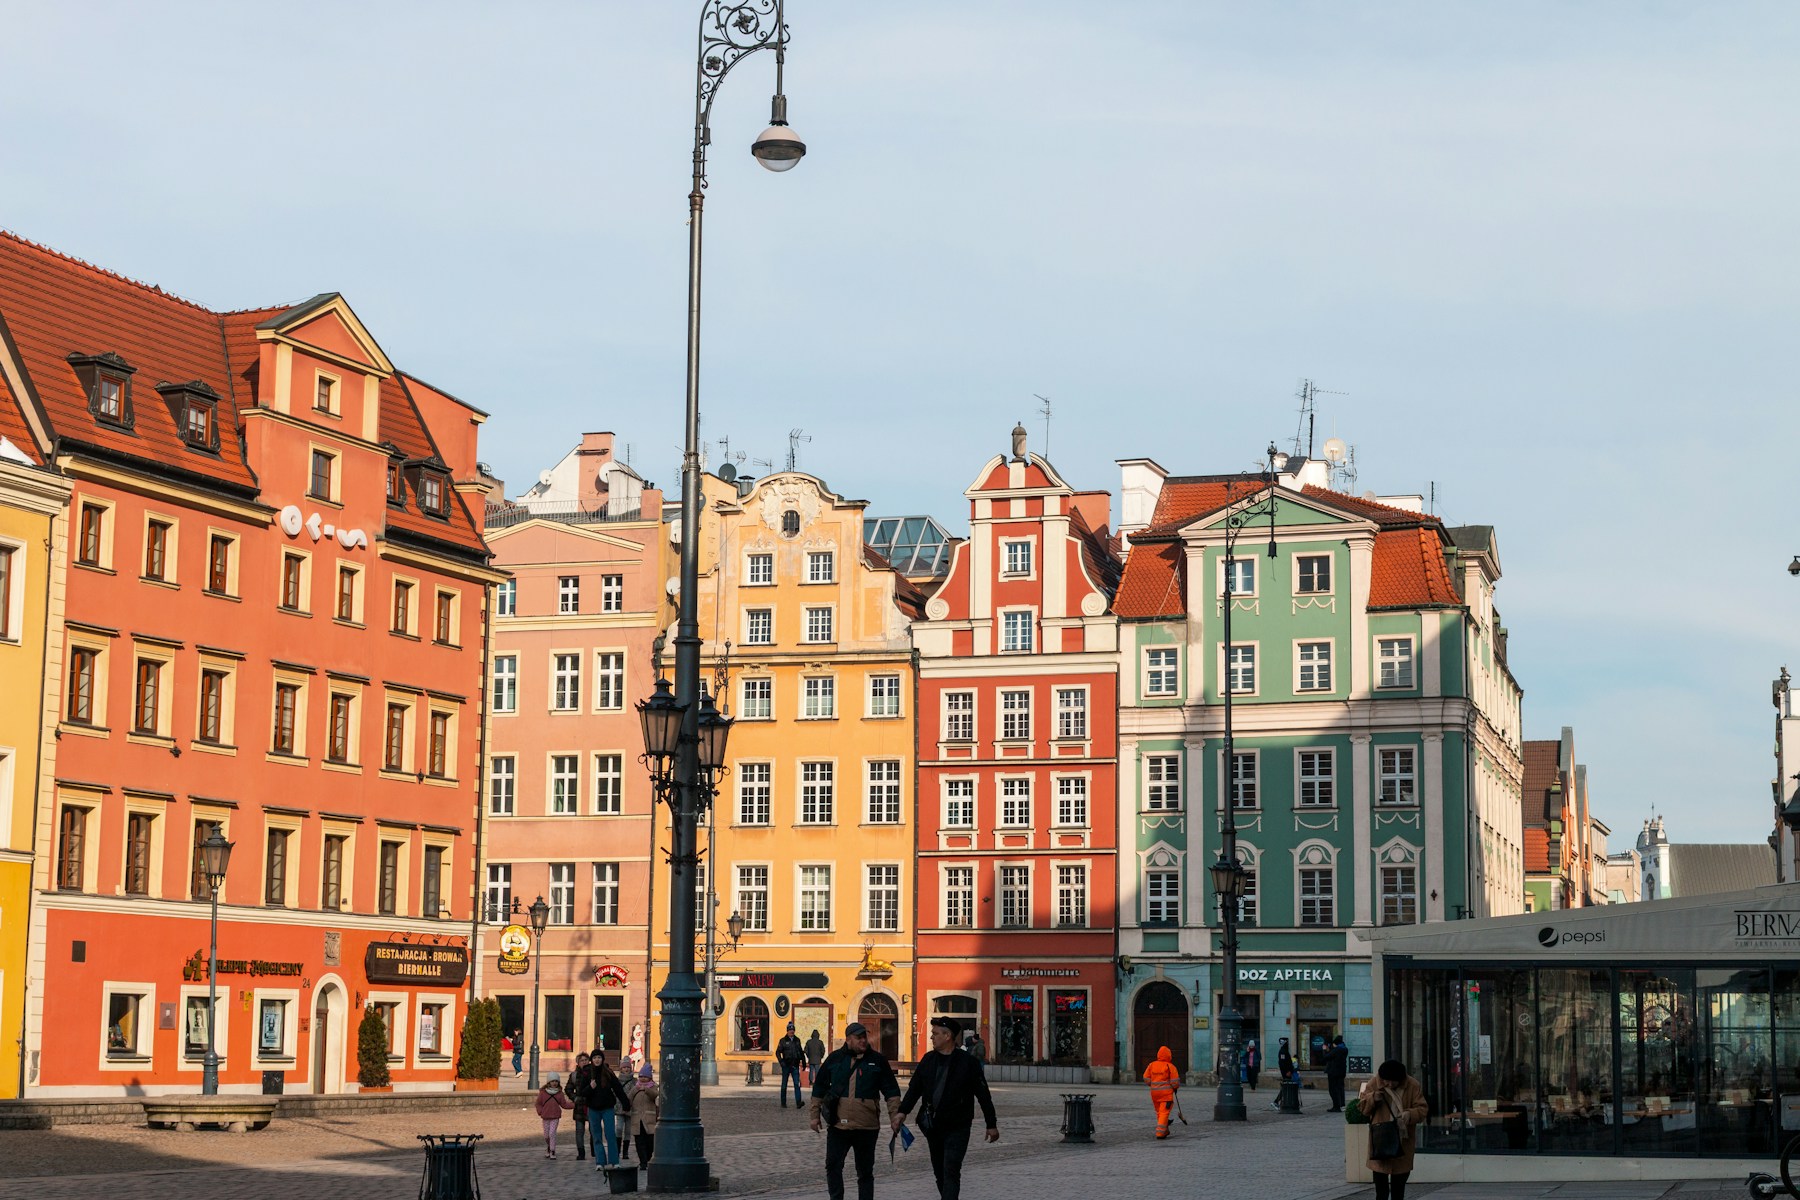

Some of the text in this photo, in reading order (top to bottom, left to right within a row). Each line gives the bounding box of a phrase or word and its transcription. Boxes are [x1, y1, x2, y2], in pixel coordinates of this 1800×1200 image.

[1562, 930, 1606, 944] pepsi
[398, 963, 441, 976] BIERHALLE
[1239, 969, 1333, 981] DOZ APTEKA
[302, 978, 311, 988] 24
